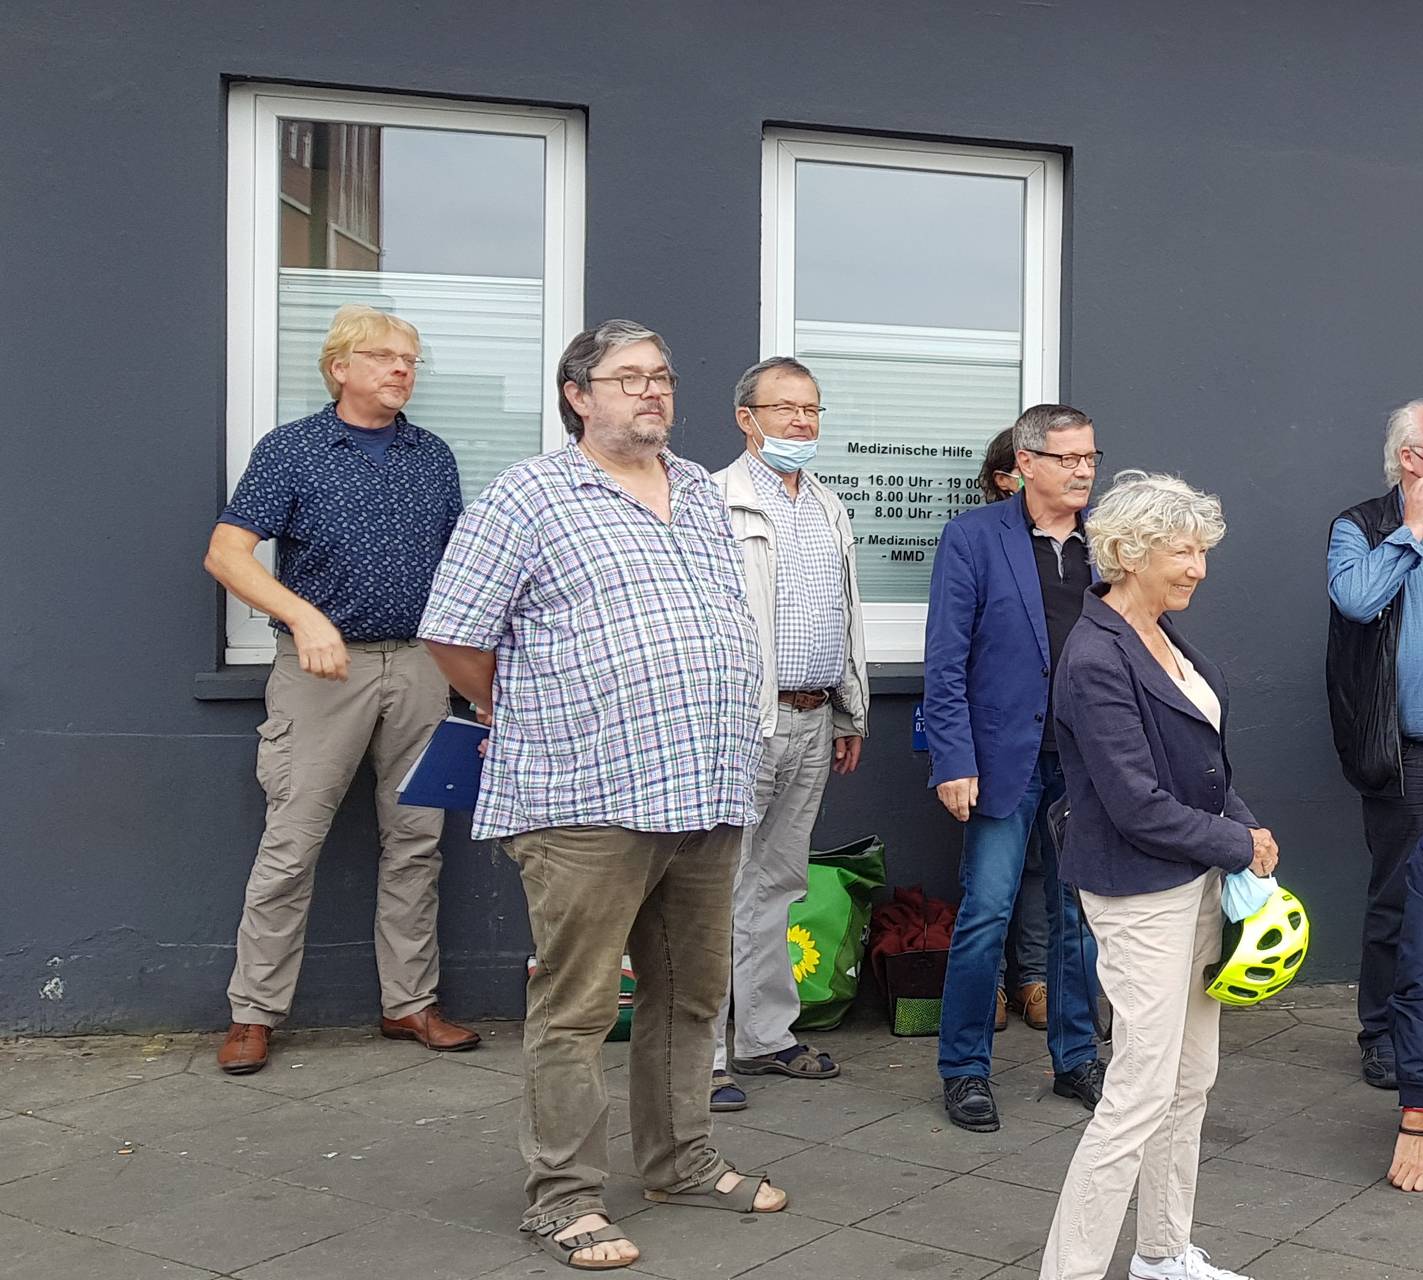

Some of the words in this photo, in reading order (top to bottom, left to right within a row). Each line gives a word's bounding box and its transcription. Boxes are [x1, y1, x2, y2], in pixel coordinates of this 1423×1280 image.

[848, 442, 938, 457] Medizinische
[942, 445, 973, 458] Hilfe
[868, 474, 904, 487] 16.00
[908, 475, 933, 488] Uhr
[837, 490, 870, 501] voch
[875, 490, 903, 503] 8.00
[908, 491, 933, 504] Uhr
[947, 493, 981, 505] 11.00
[875, 507, 903, 519] 8.00
[907, 507, 932, 520] Uhr
[868, 534, 941, 547] Medizinisch
[891, 550, 925, 562] MMD
